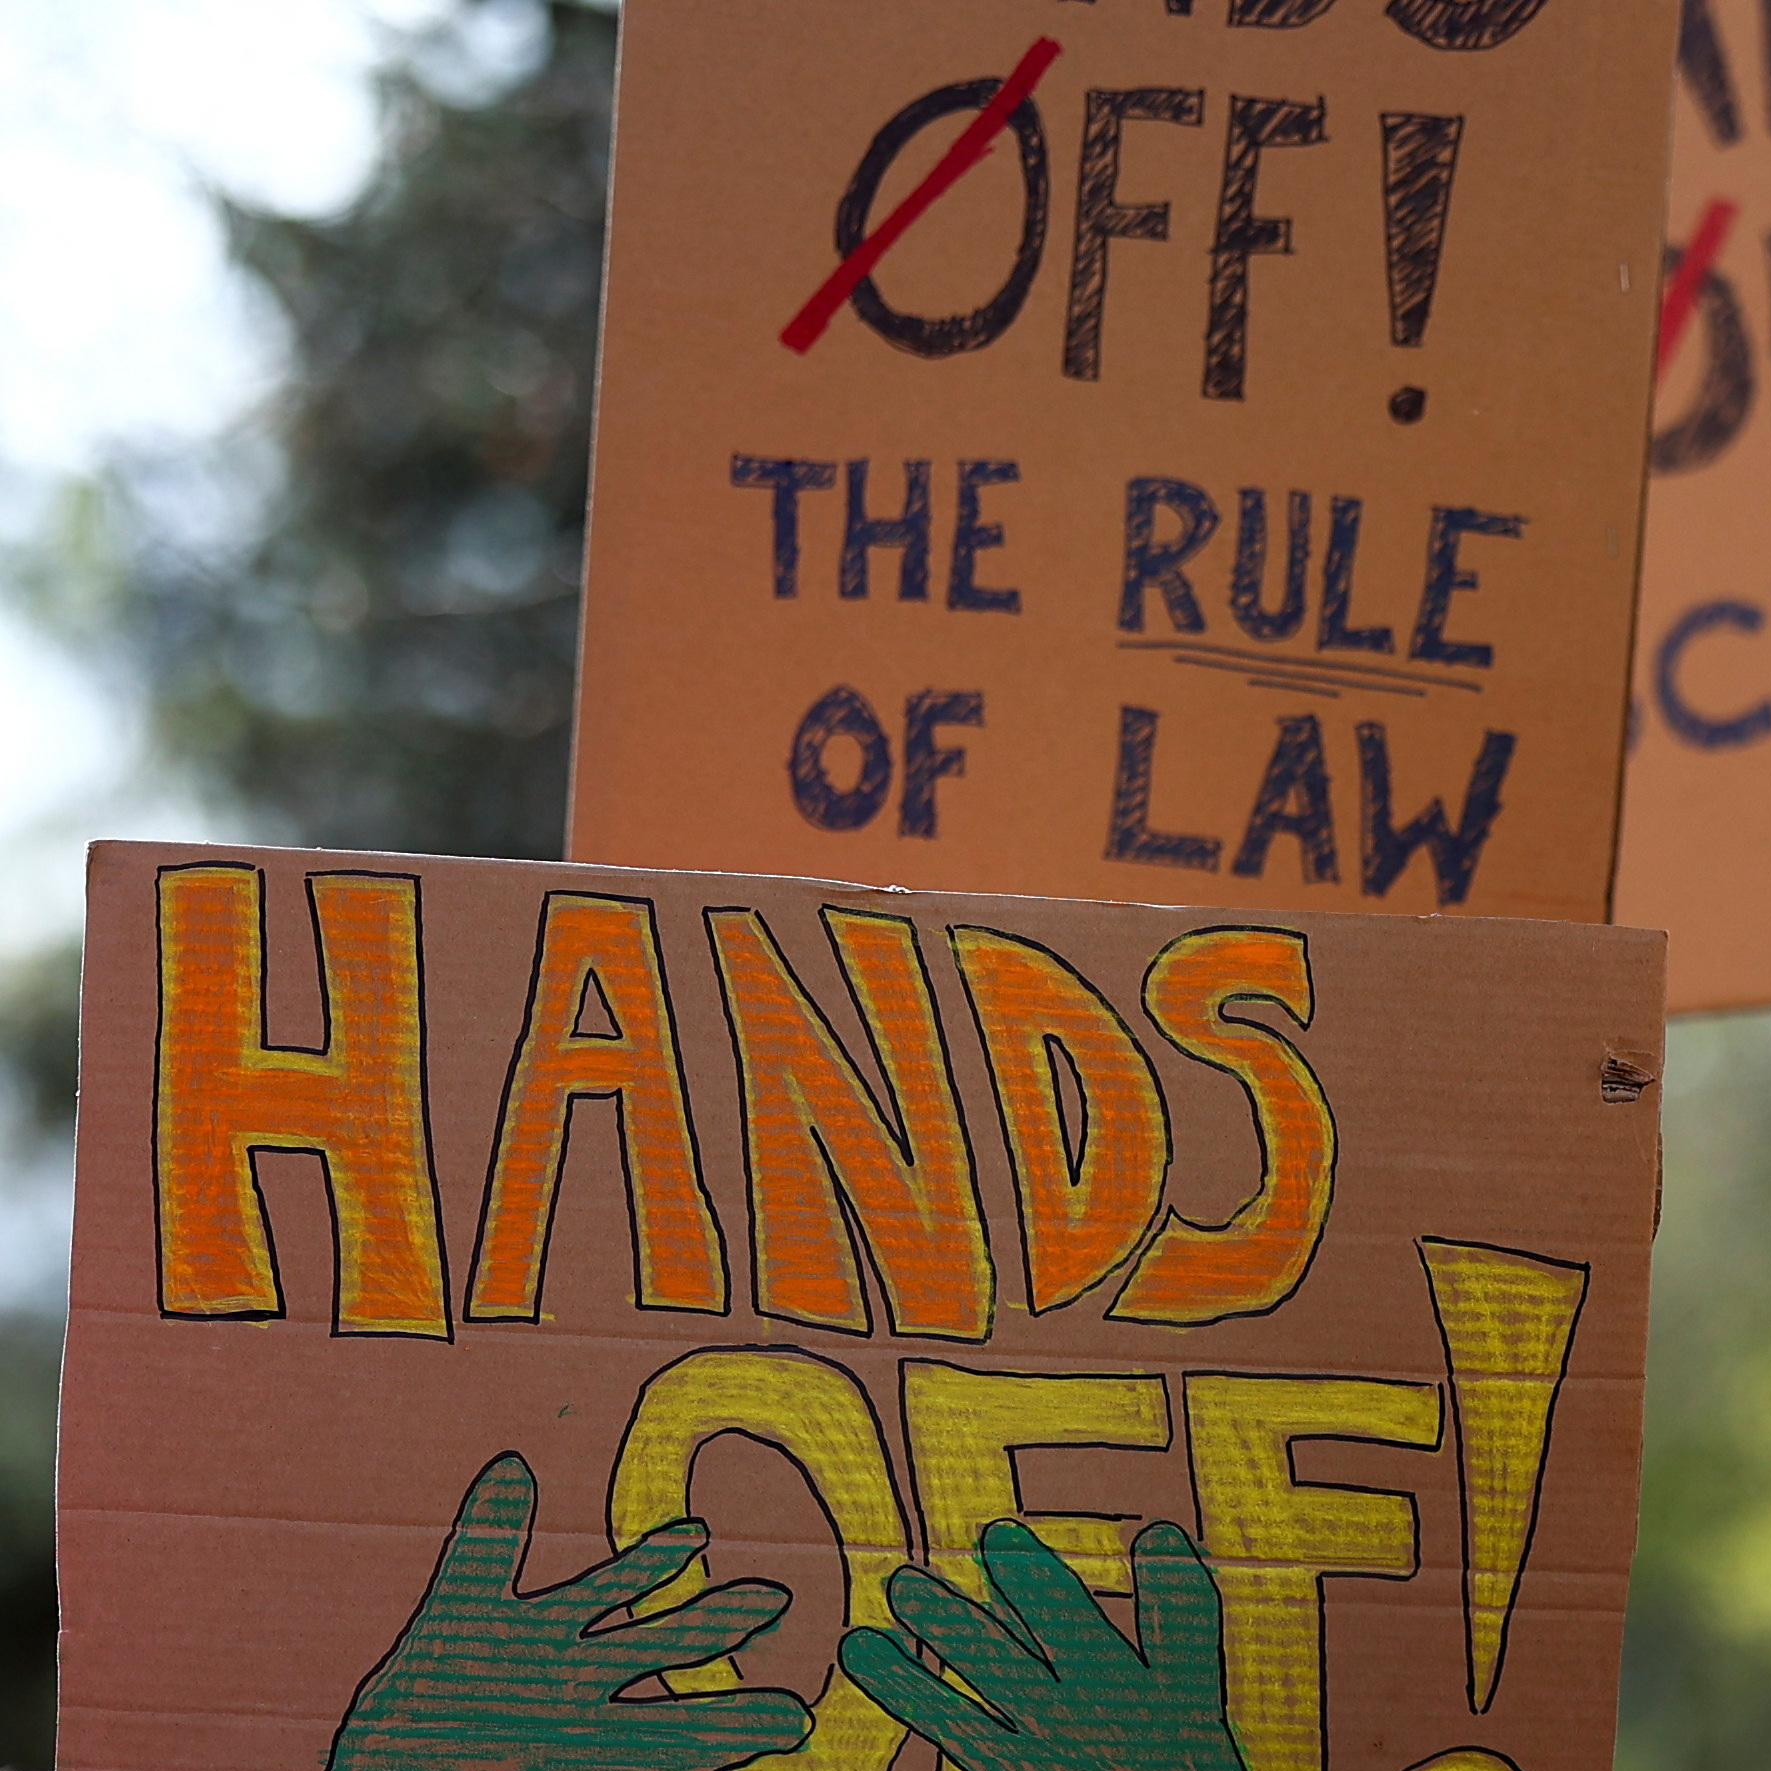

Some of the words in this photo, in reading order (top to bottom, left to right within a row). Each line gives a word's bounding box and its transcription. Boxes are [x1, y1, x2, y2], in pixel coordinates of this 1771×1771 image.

[730, 453, 1023, 615] THE
[1117, 477, 1528, 670] RULE
[789, 682, 985, 840] OF
[1105, 706, 1515, 906] LAW
[154, 861, 1338, 1344] HANDS
